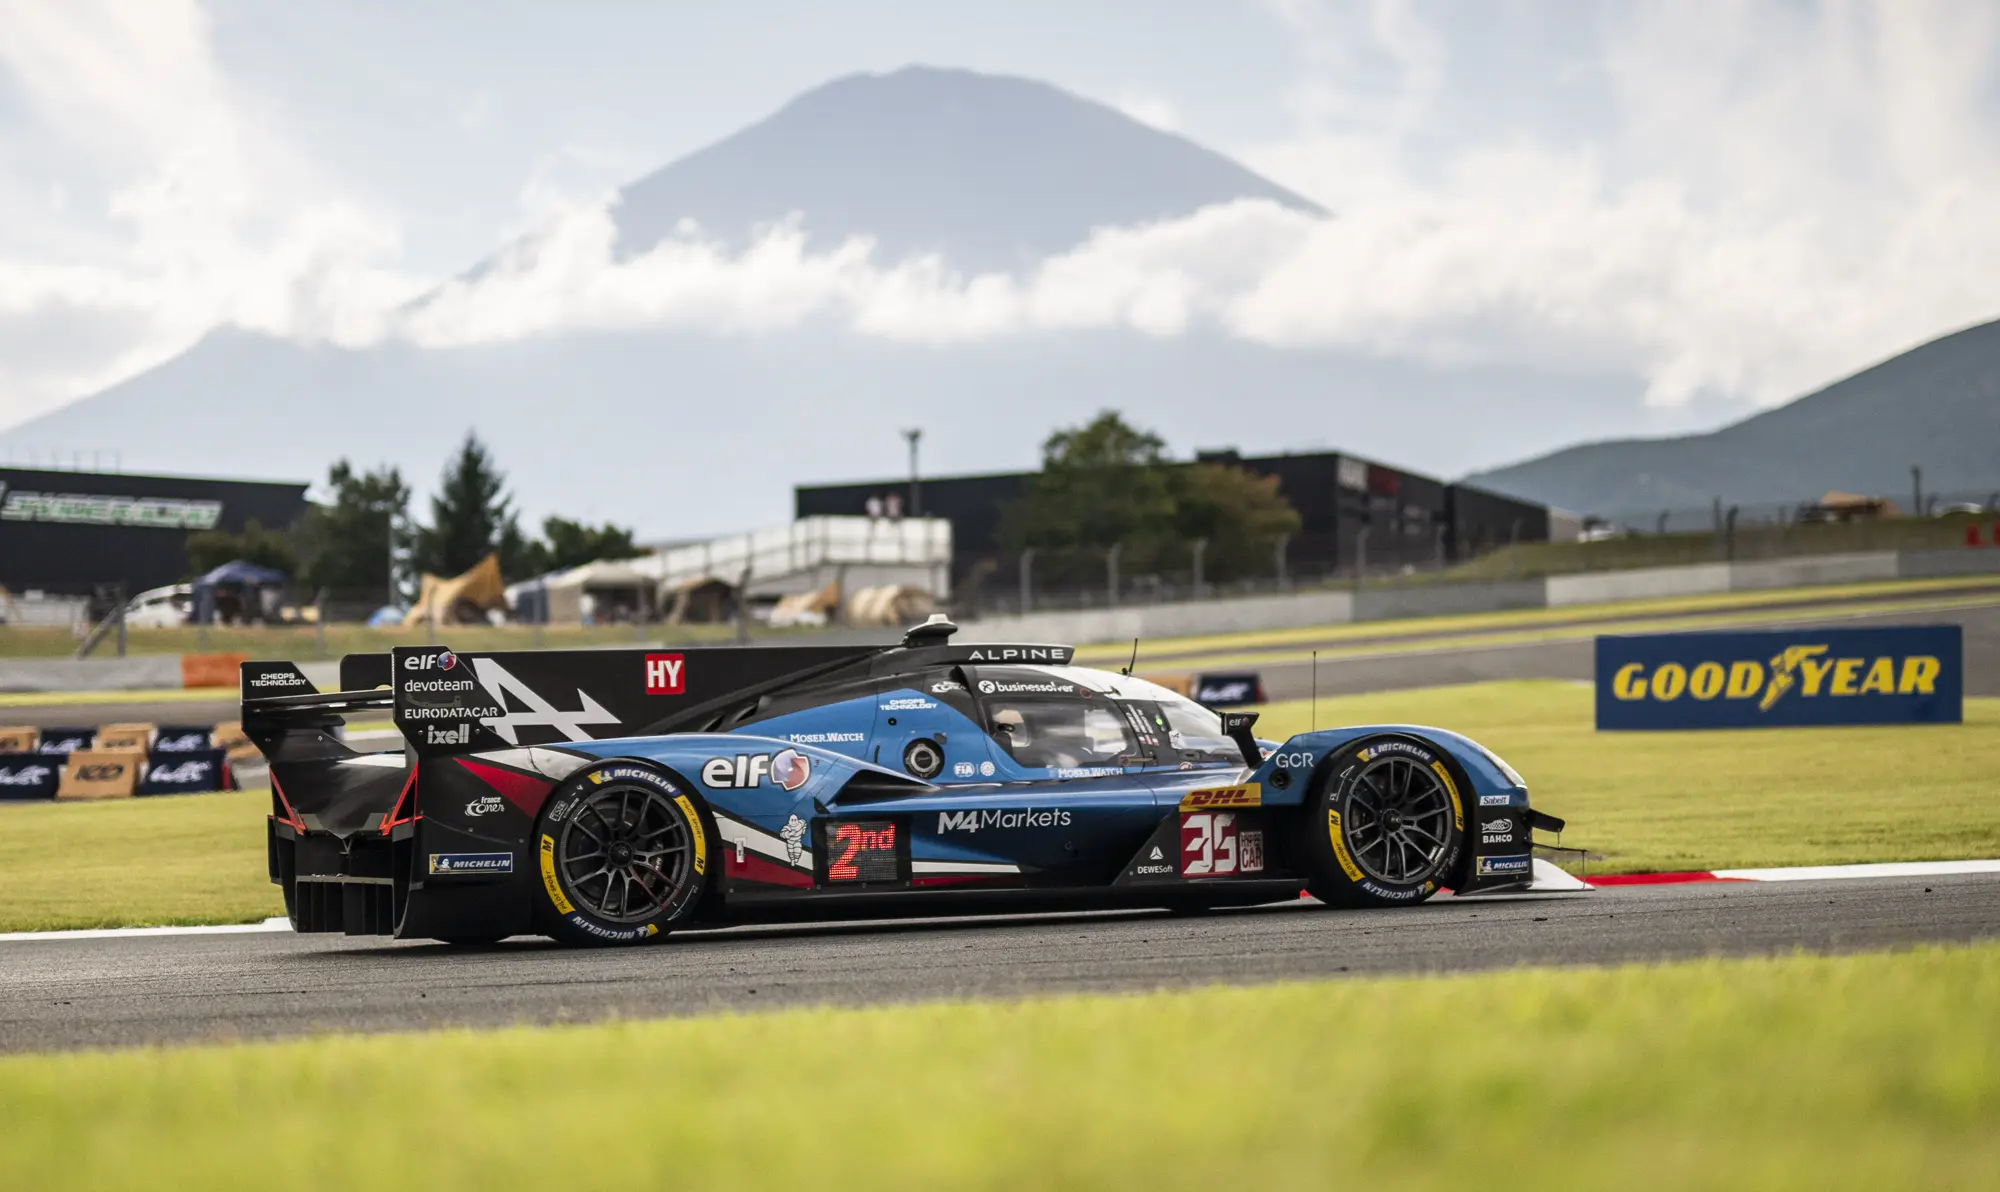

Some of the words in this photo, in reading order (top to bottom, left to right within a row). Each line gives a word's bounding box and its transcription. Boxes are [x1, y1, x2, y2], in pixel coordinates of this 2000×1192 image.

[404, 654, 437, 670] elf
[969, 648, 1065, 660] ALPINE
[647, 661, 683, 688] HY
[250, 679, 307, 687] TECHNOLOGY
[404, 678, 474, 692] devoteam
[996, 681, 1074, 692] businessolver
[404, 707, 499, 719] EURODATACAR
[880, 703, 938, 711] TECHNOLOGY
[427, 723, 471, 745] ixell
[1377, 742, 1432, 760] MICHELIN
[1275, 752, 1315, 768] GCR
[702, 756, 769, 789] elf
[613, 768, 676, 794] MICHELIN
[1190, 789, 1250, 805] DHL
[542, 839, 552, 851] M
[1182, 814, 1236, 874] 35
[1482, 834, 1513, 843] BAHCO
[828, 823, 896, 881] 2nd
[1242, 847, 1263, 868] CAR
[453, 859, 511, 868] MICHELIN
[695, 857, 705, 869] M
[1137, 865, 1174, 875] DEWESoft
[1363, 881, 1417, 899] MICHELIN
[570, 914, 636, 939] MICHELIN
